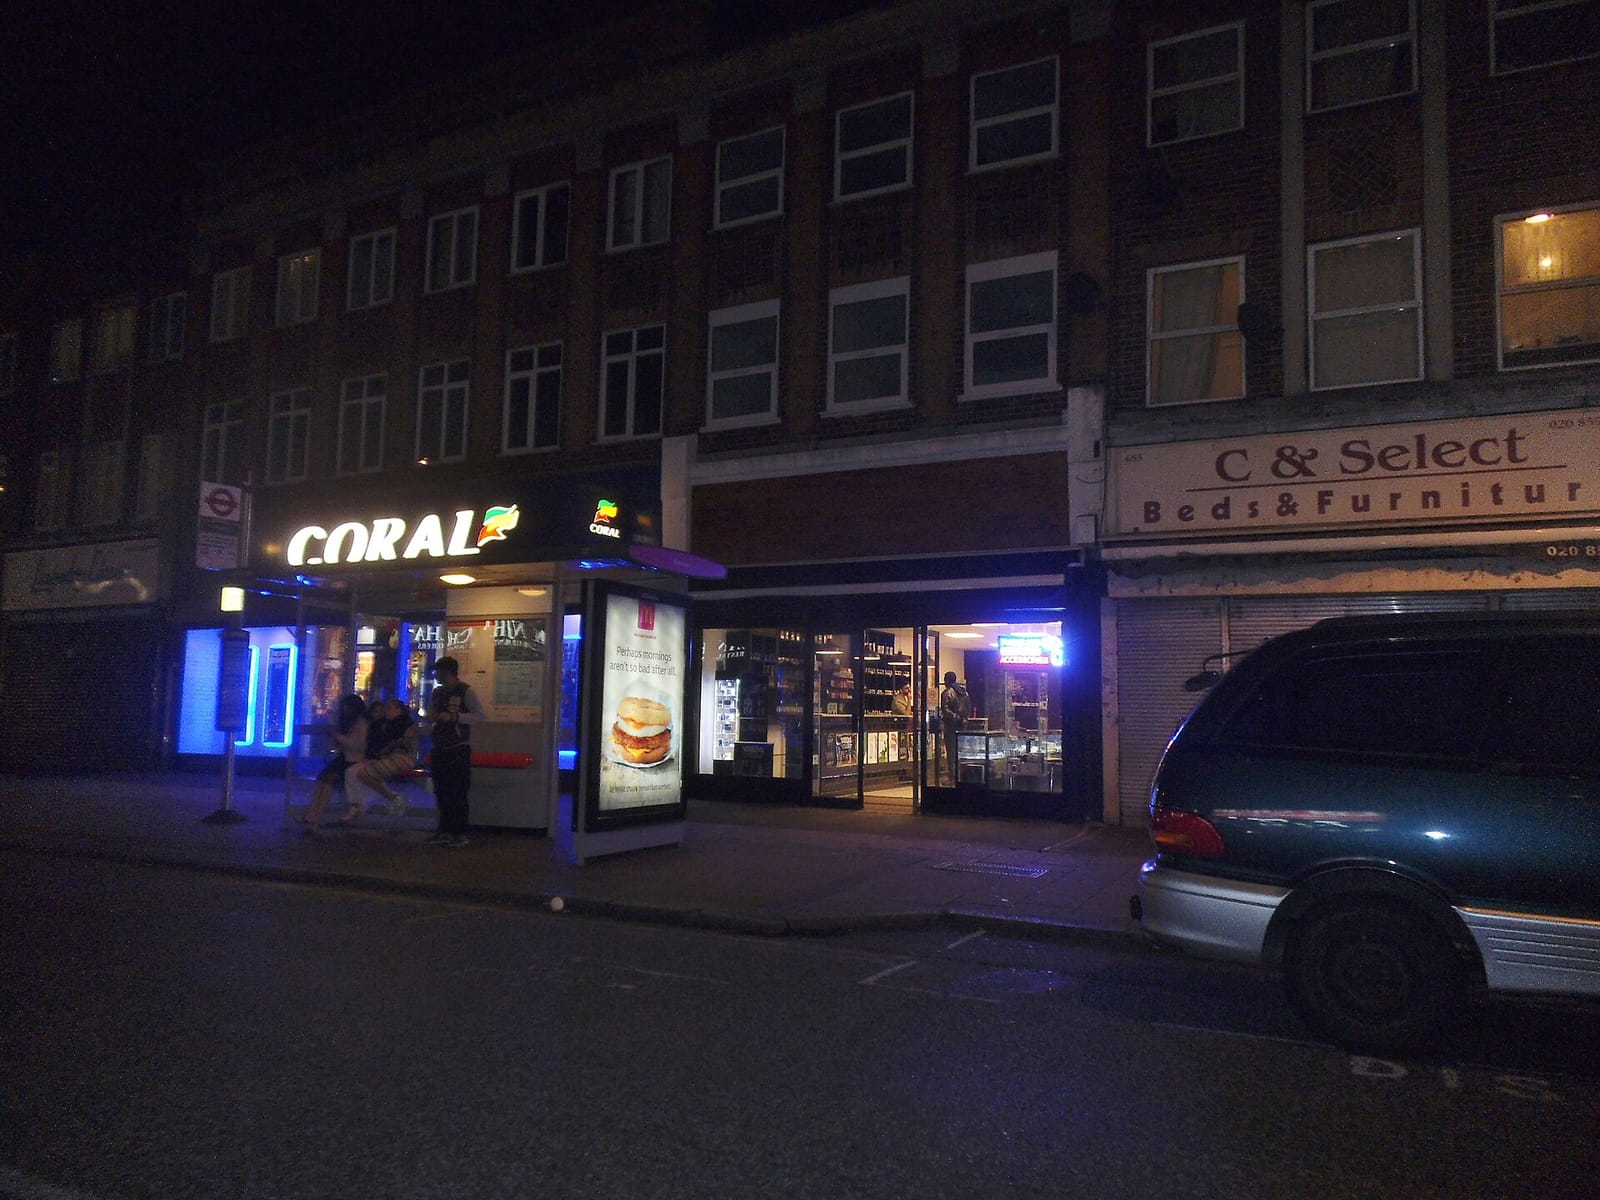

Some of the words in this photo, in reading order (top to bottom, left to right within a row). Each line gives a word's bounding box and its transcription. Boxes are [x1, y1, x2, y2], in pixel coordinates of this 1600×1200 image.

[1215, 448, 1252, 482] C
[1271, 445, 1318, 478] &
[1339, 427, 1529, 475] Select
[287, 510, 480, 567] CORAL
[589, 522, 621, 539] CORAL
[1547, 545, 1578, 557] 020
[1585, 544, 1600, 557] 8
[616, 645, 642, 659] Perhaps
[643, 650, 672, 663] mornings
[609, 661, 629, 672] aren't
[630, 664, 638, 673] so
[638, 662, 651, 674] bad
[651, 663, 667, 675] after
